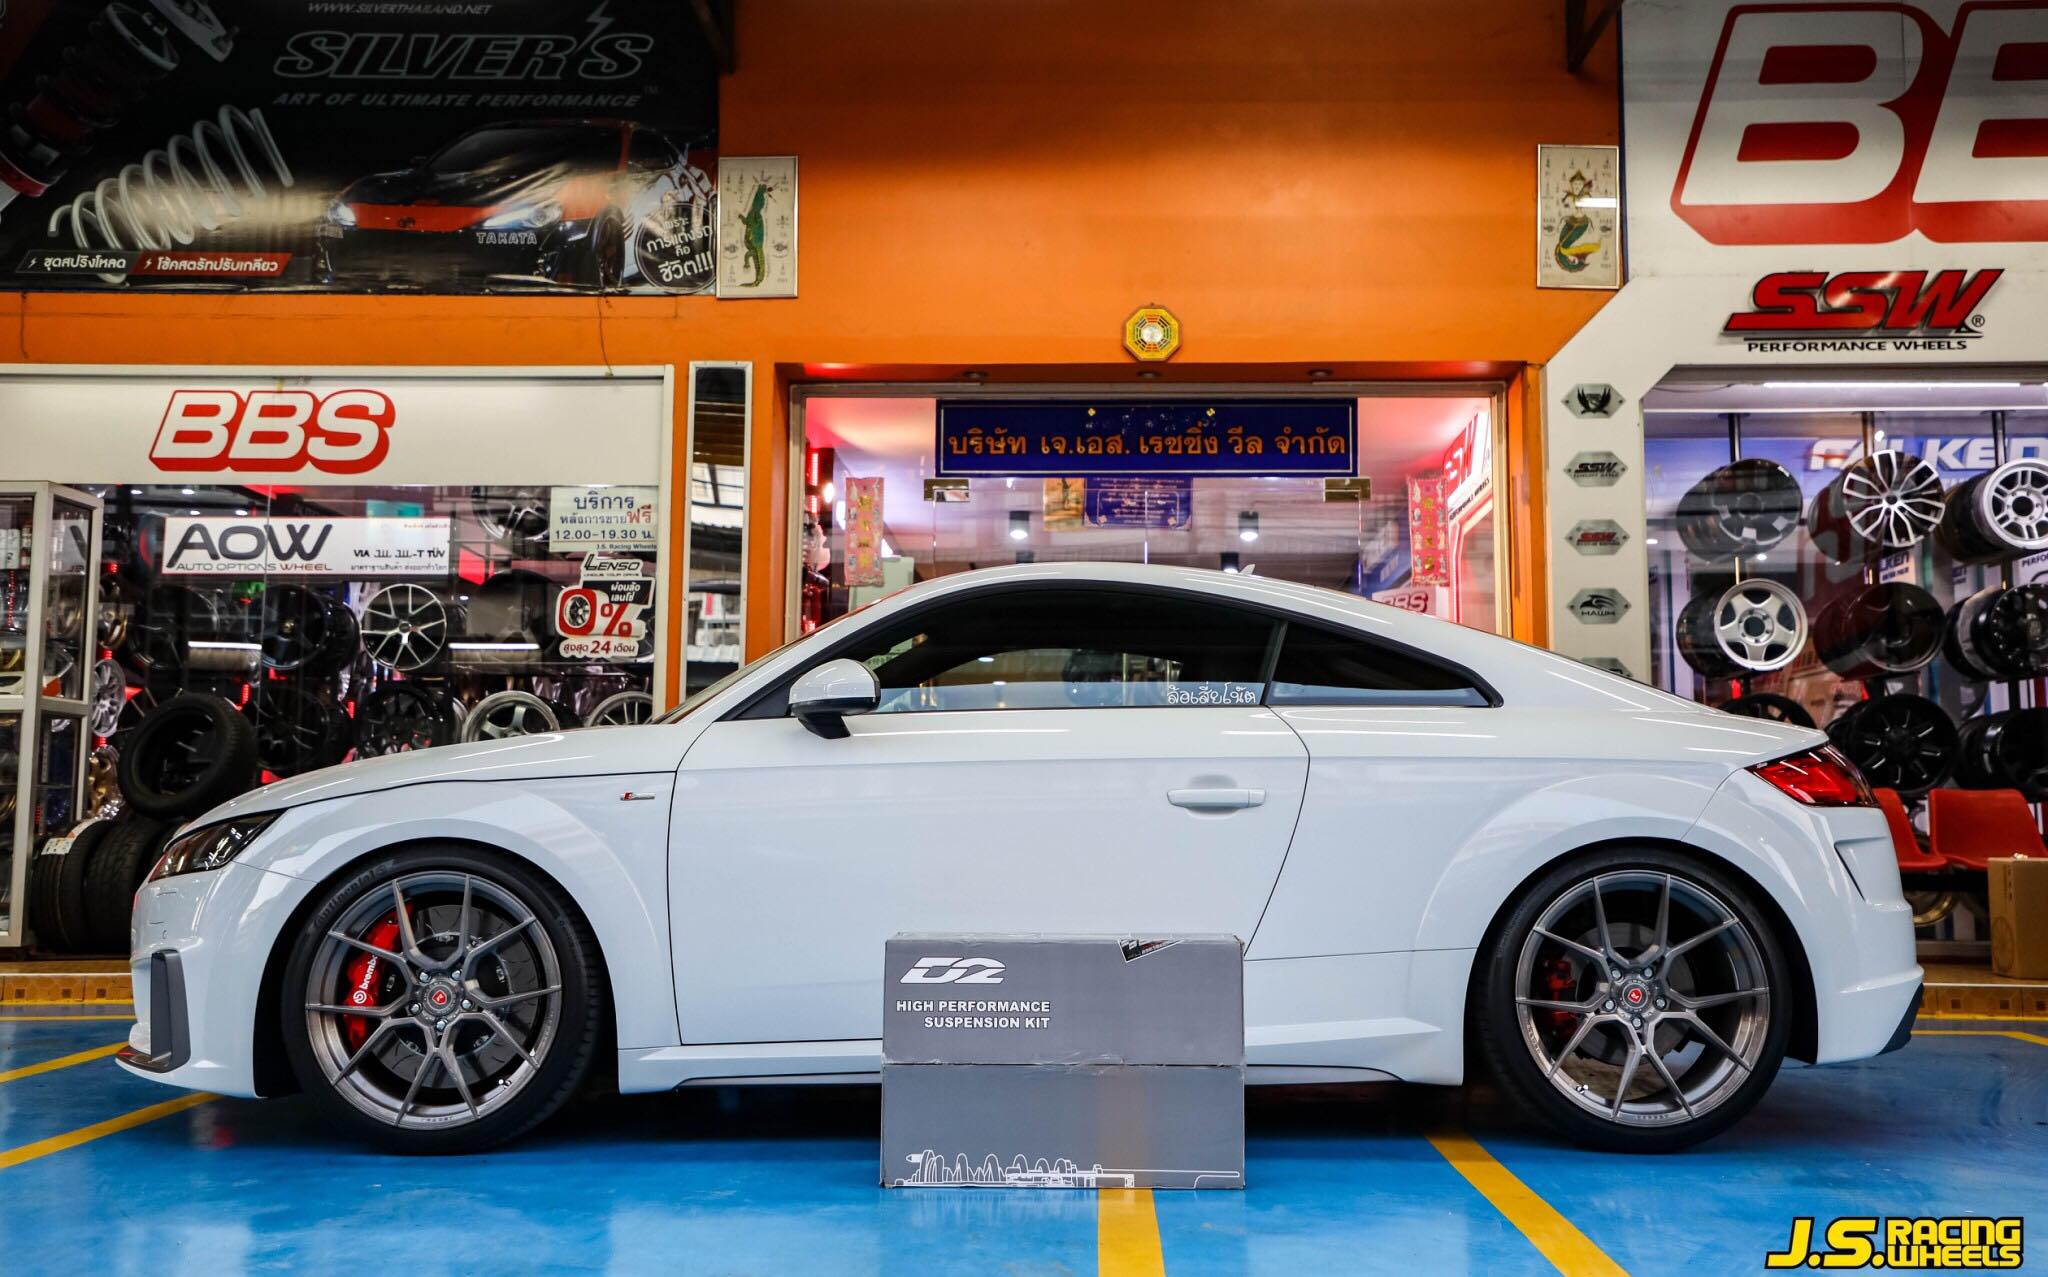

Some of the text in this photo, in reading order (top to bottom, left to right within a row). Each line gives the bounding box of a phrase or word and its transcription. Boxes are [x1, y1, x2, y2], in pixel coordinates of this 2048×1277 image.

[273, 93, 321, 105] ART
[325, 93, 358, 105] OF
[361, 93, 472, 106] ULTIMATE
[475, 93, 642, 107] PERFORMANCE
[475, 232, 538, 245] TAKATA
[675, 244, 691, 257] คือ
[1723, 269, 2004, 331] SSW
[1747, 339, 1968, 353] PERFORMANCE WHEELS
[149, 389, 396, 474] BBS
[948, 427, 1027, 455] บริษัท
[1227, 425, 1263, 454] วีล
[1275, 426, 1345, 454] จำกัด
[574, 490, 634, 510] บริการ
[555, 529, 637, 540] 12.00-19.30
[166, 523, 333, 569] AOW
[609, 543, 631, 551] Racing
[353, 549, 370, 558] VIA
[176, 562, 333, 571] AUTO OPTIONS WHEEL
[584, 554, 640, 571] LENSO
[590, 640, 611, 654] 24
[899, 957, 1007, 984] D2
[896, 1000, 1051, 1013] HIGH PERFORMANCE
[924, 1016, 1051, 1029] SUSPENSION KIT
